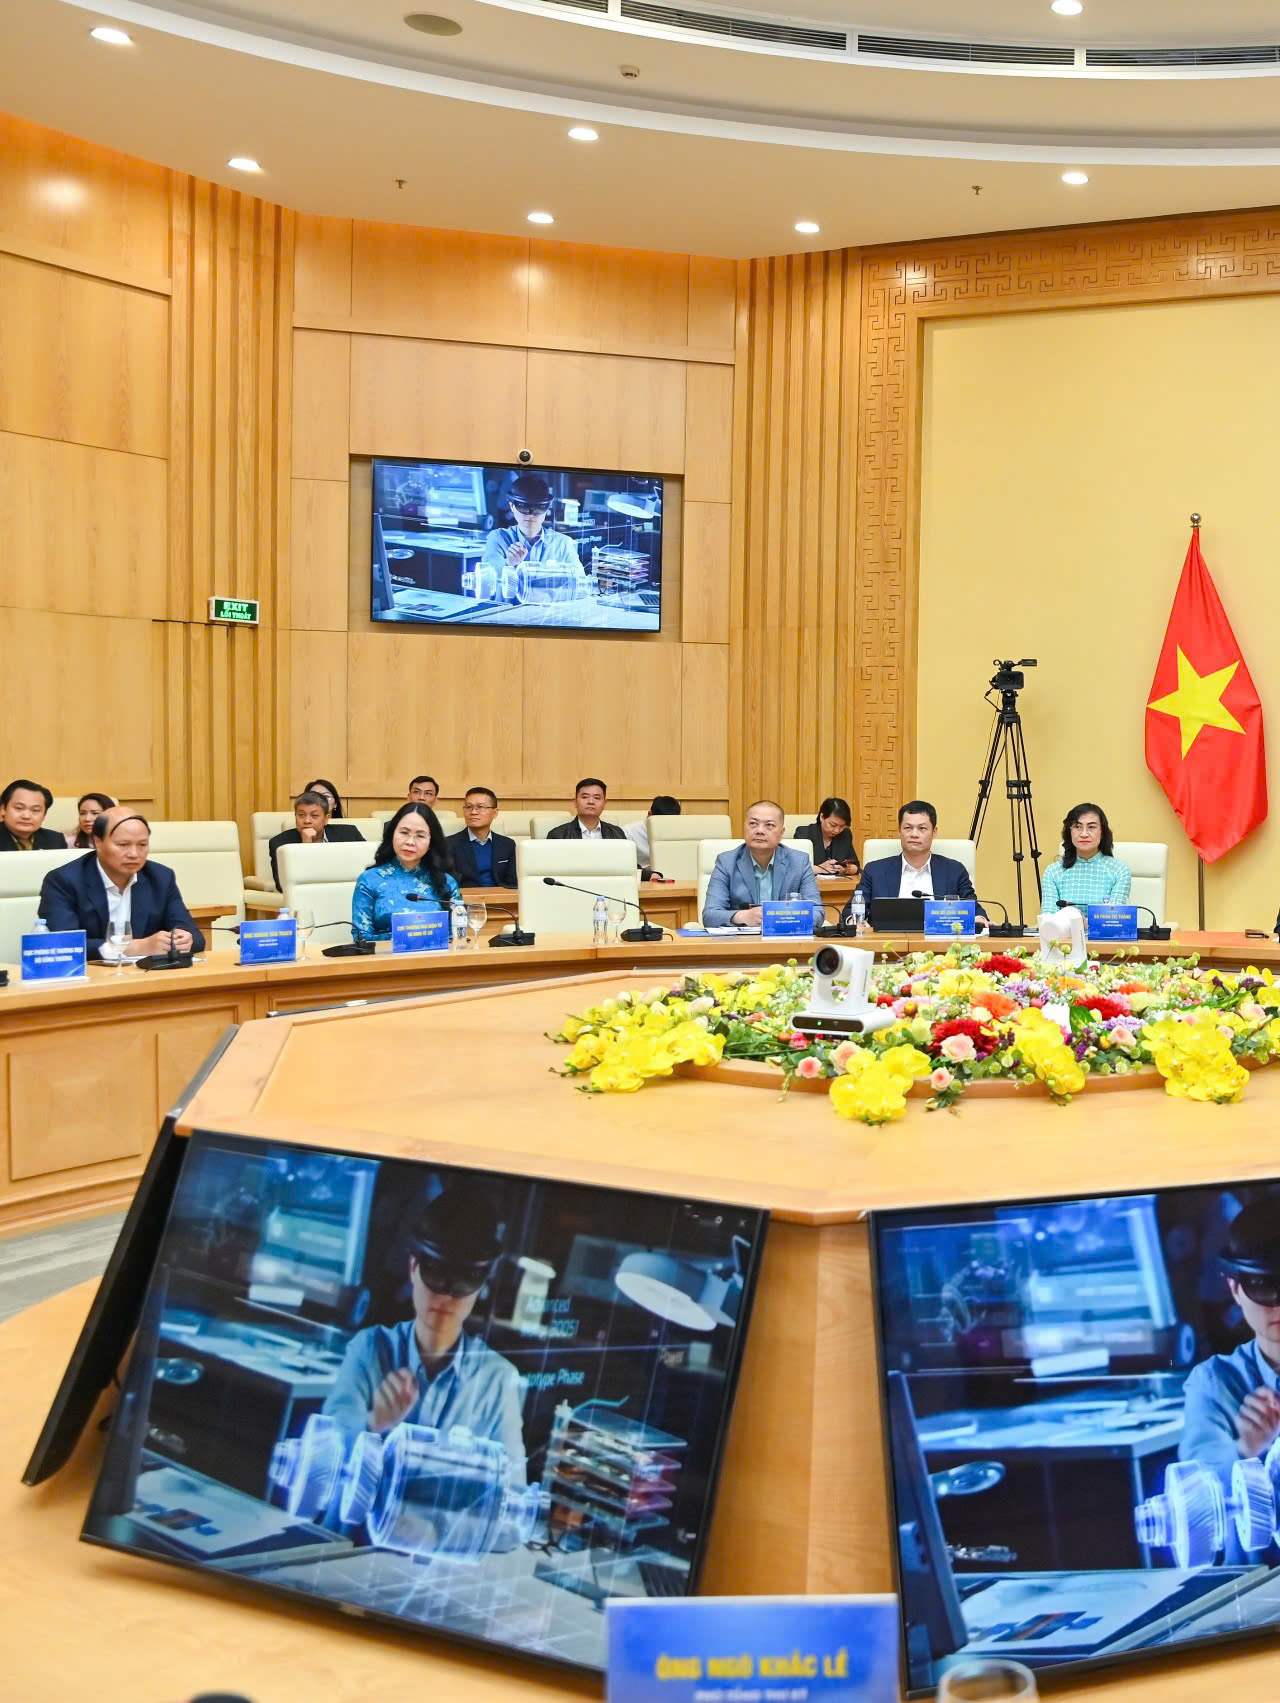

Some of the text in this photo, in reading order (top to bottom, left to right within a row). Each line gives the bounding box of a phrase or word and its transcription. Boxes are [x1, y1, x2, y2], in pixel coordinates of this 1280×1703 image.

[224, 602, 249, 611] EXIT
[557, 1368, 585, 1385] Phase
[656, 1652, 701, 1680] ÔNG
[707, 1652, 753, 1678] NGÔ
